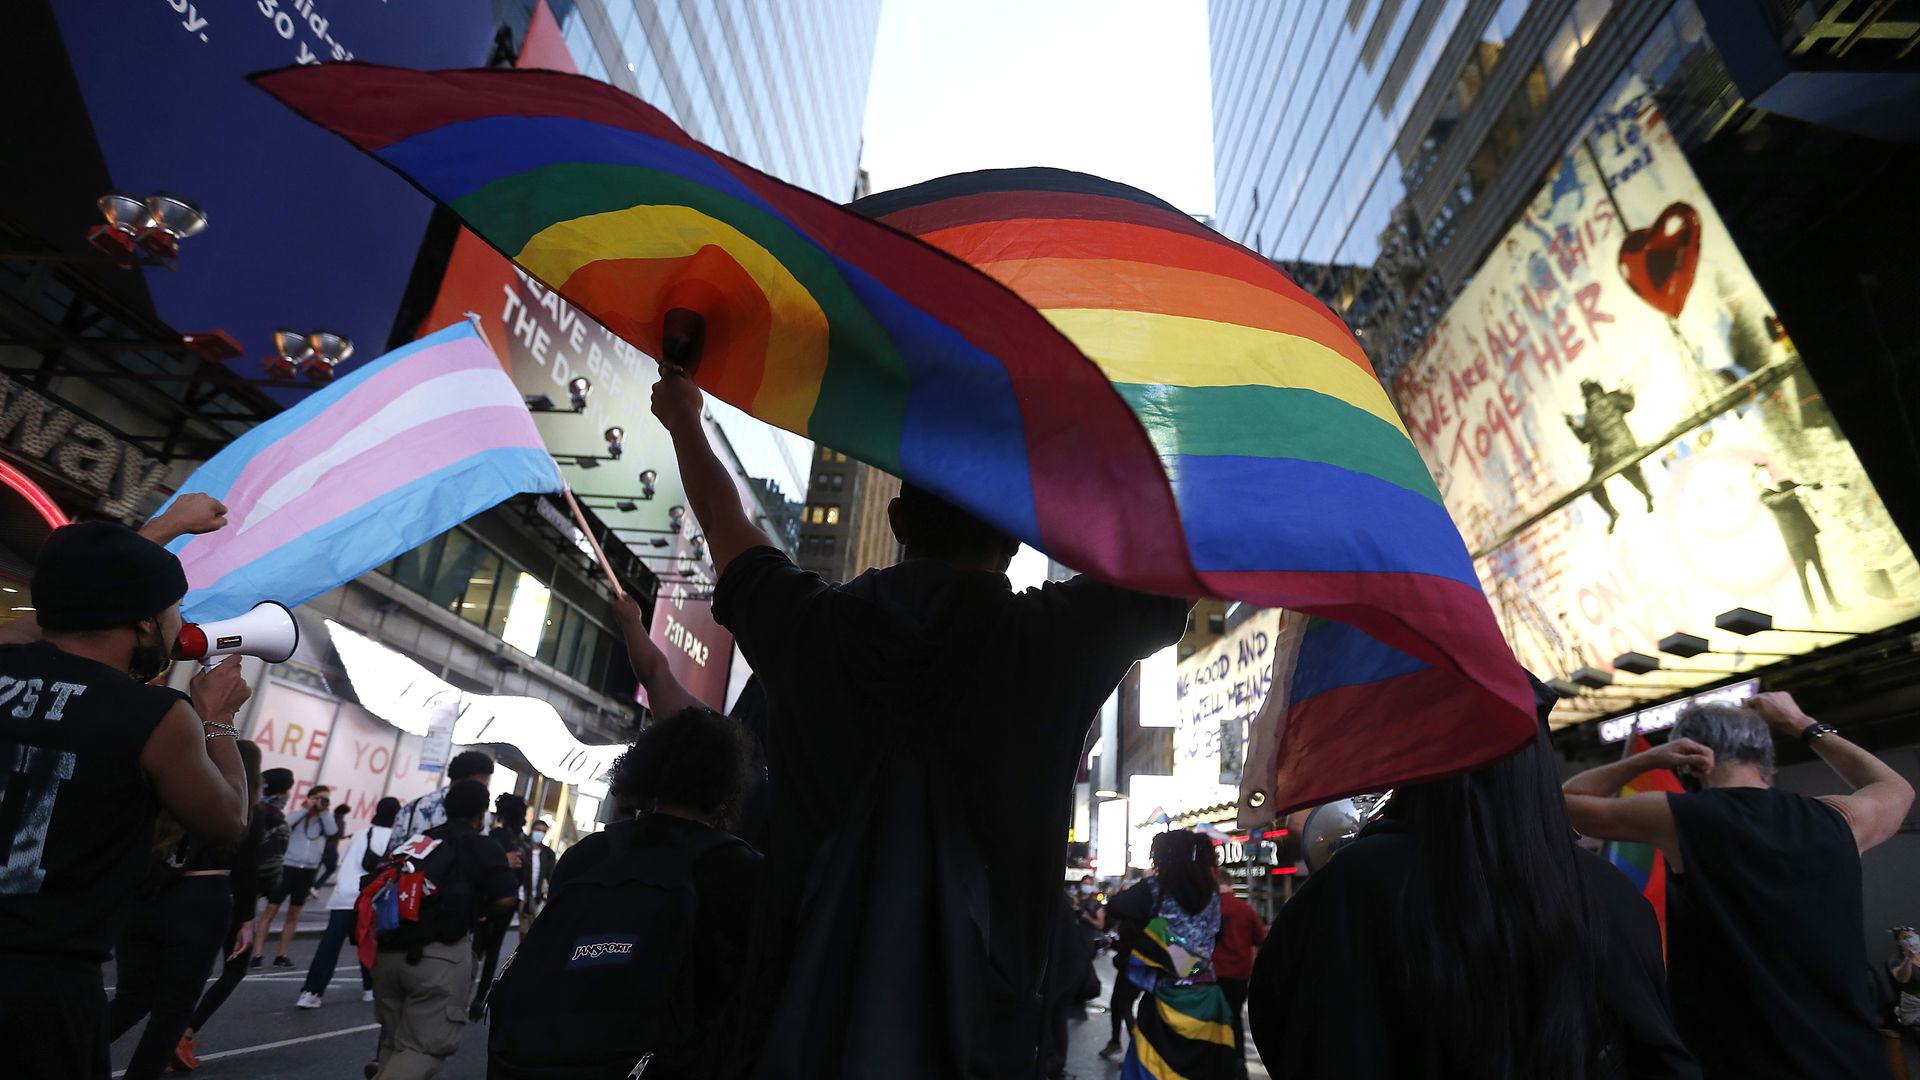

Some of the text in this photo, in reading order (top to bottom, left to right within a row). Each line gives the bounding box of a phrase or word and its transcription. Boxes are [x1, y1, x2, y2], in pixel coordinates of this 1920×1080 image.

[502, 283, 551, 367] THE
[513, 264, 588, 355] EAVE
[1407, 381, 1451, 447] WE
[1449, 353, 1488, 417] ARE
[1450, 281, 1616, 481] TOGETHER
[1194, 654, 1230, 686] GOOD
[1237, 631, 1268, 672] AND
[254, 719, 412, 780] ARE YOU
[571, 942, 633, 961] JANSPORT
